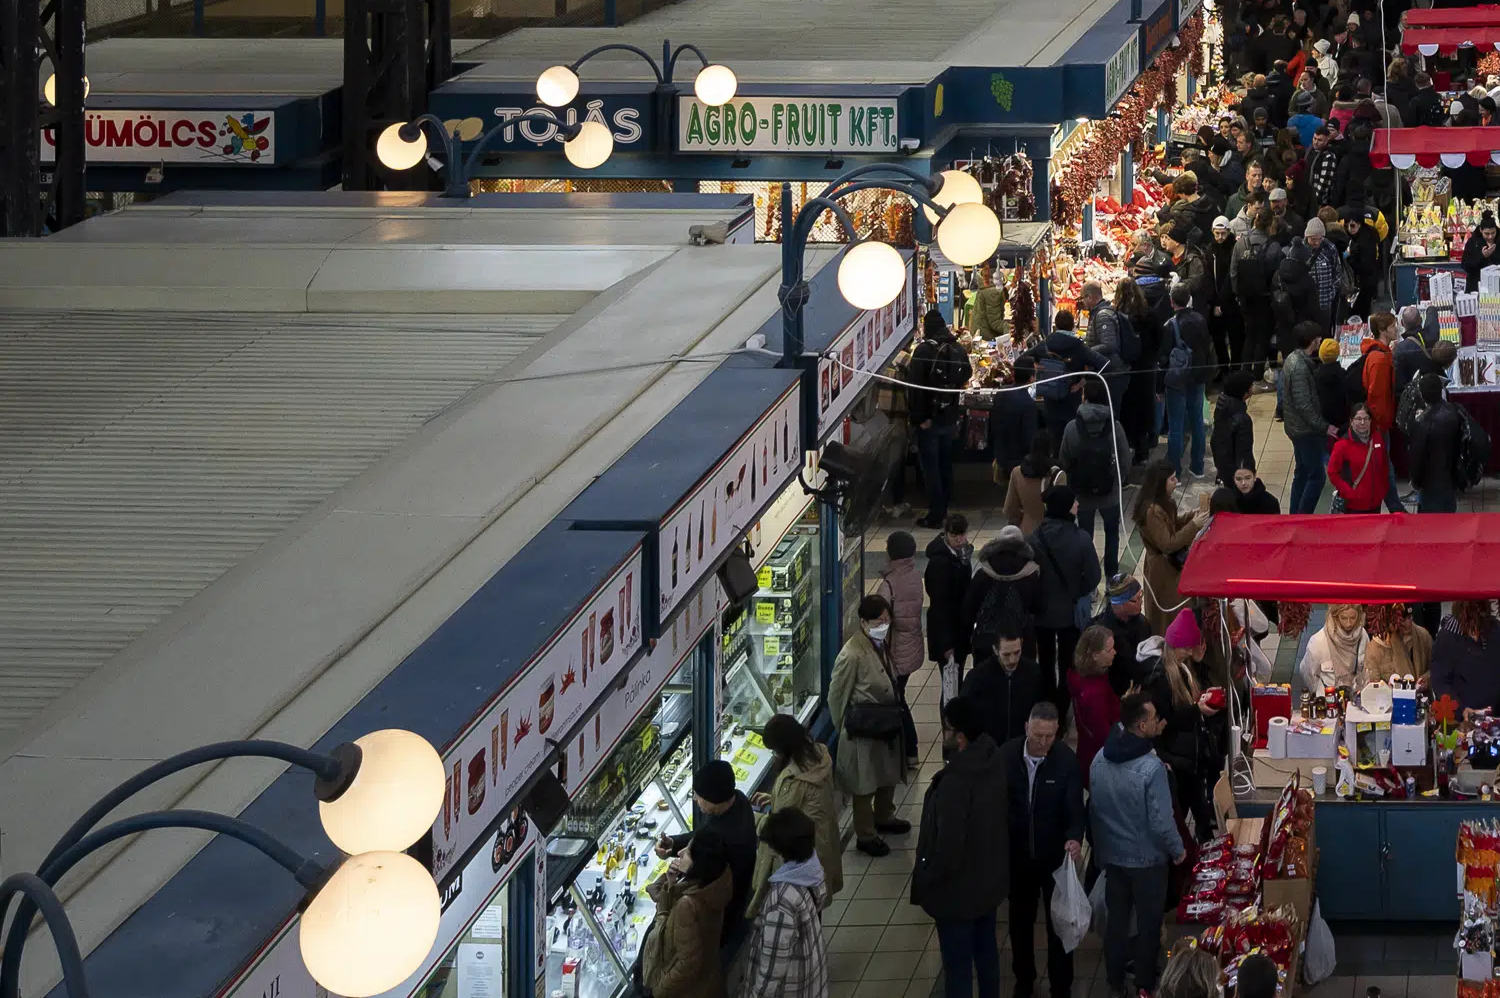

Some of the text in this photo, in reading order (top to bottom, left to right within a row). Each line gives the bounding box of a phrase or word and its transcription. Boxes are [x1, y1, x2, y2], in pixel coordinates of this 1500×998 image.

[44, 114, 217, 148] ÜMÖLCS
[685, 102, 897, 148] AGRO-FRUIT KFT.
[625, 670, 651, 709] Pálinka
